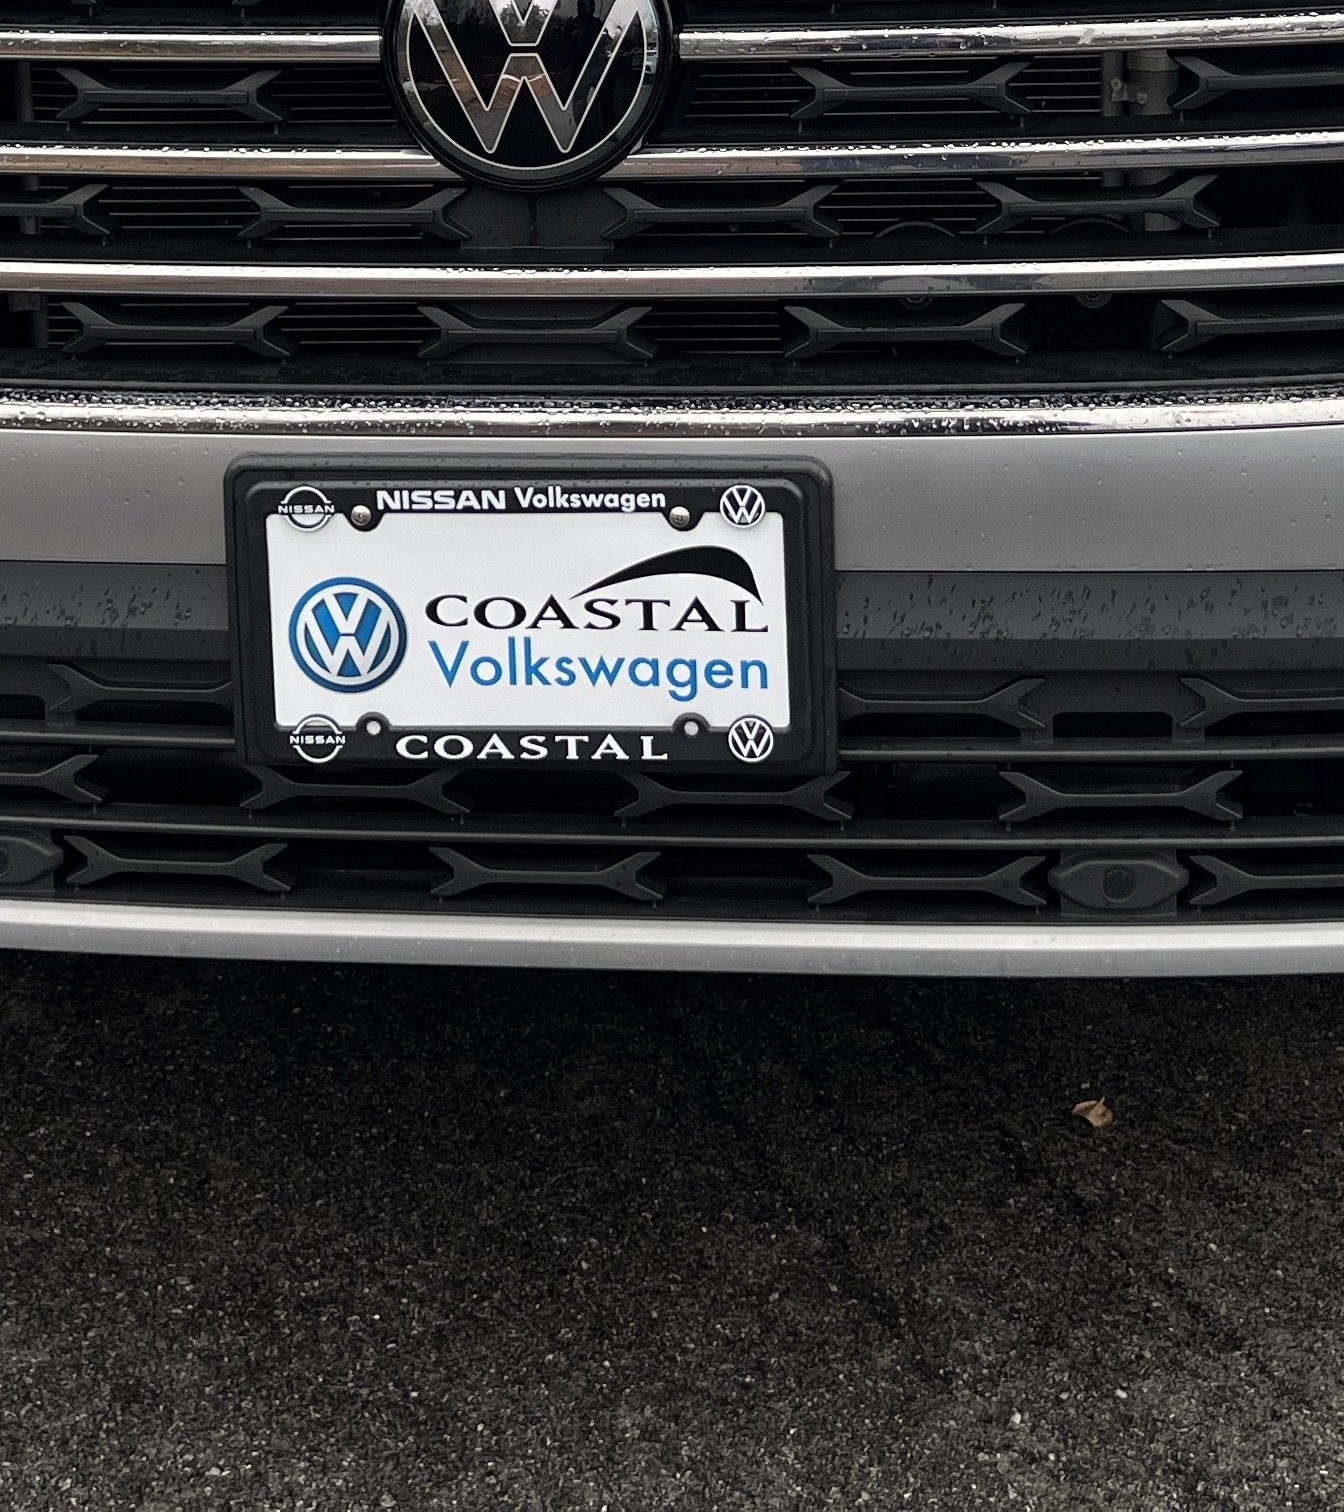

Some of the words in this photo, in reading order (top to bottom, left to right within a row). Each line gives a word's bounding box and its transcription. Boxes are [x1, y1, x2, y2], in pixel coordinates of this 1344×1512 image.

[278, 504, 335, 514] NISSAN
[377, 489, 506, 510] NISSAN
[513, 486, 666, 513] Volkswagen
[425, 594, 768, 633] COASTAL
[428, 637, 768, 702] Volkswagen
[289, 735, 346, 744] NISSAN
[395, 734, 668, 760] COASTAL
